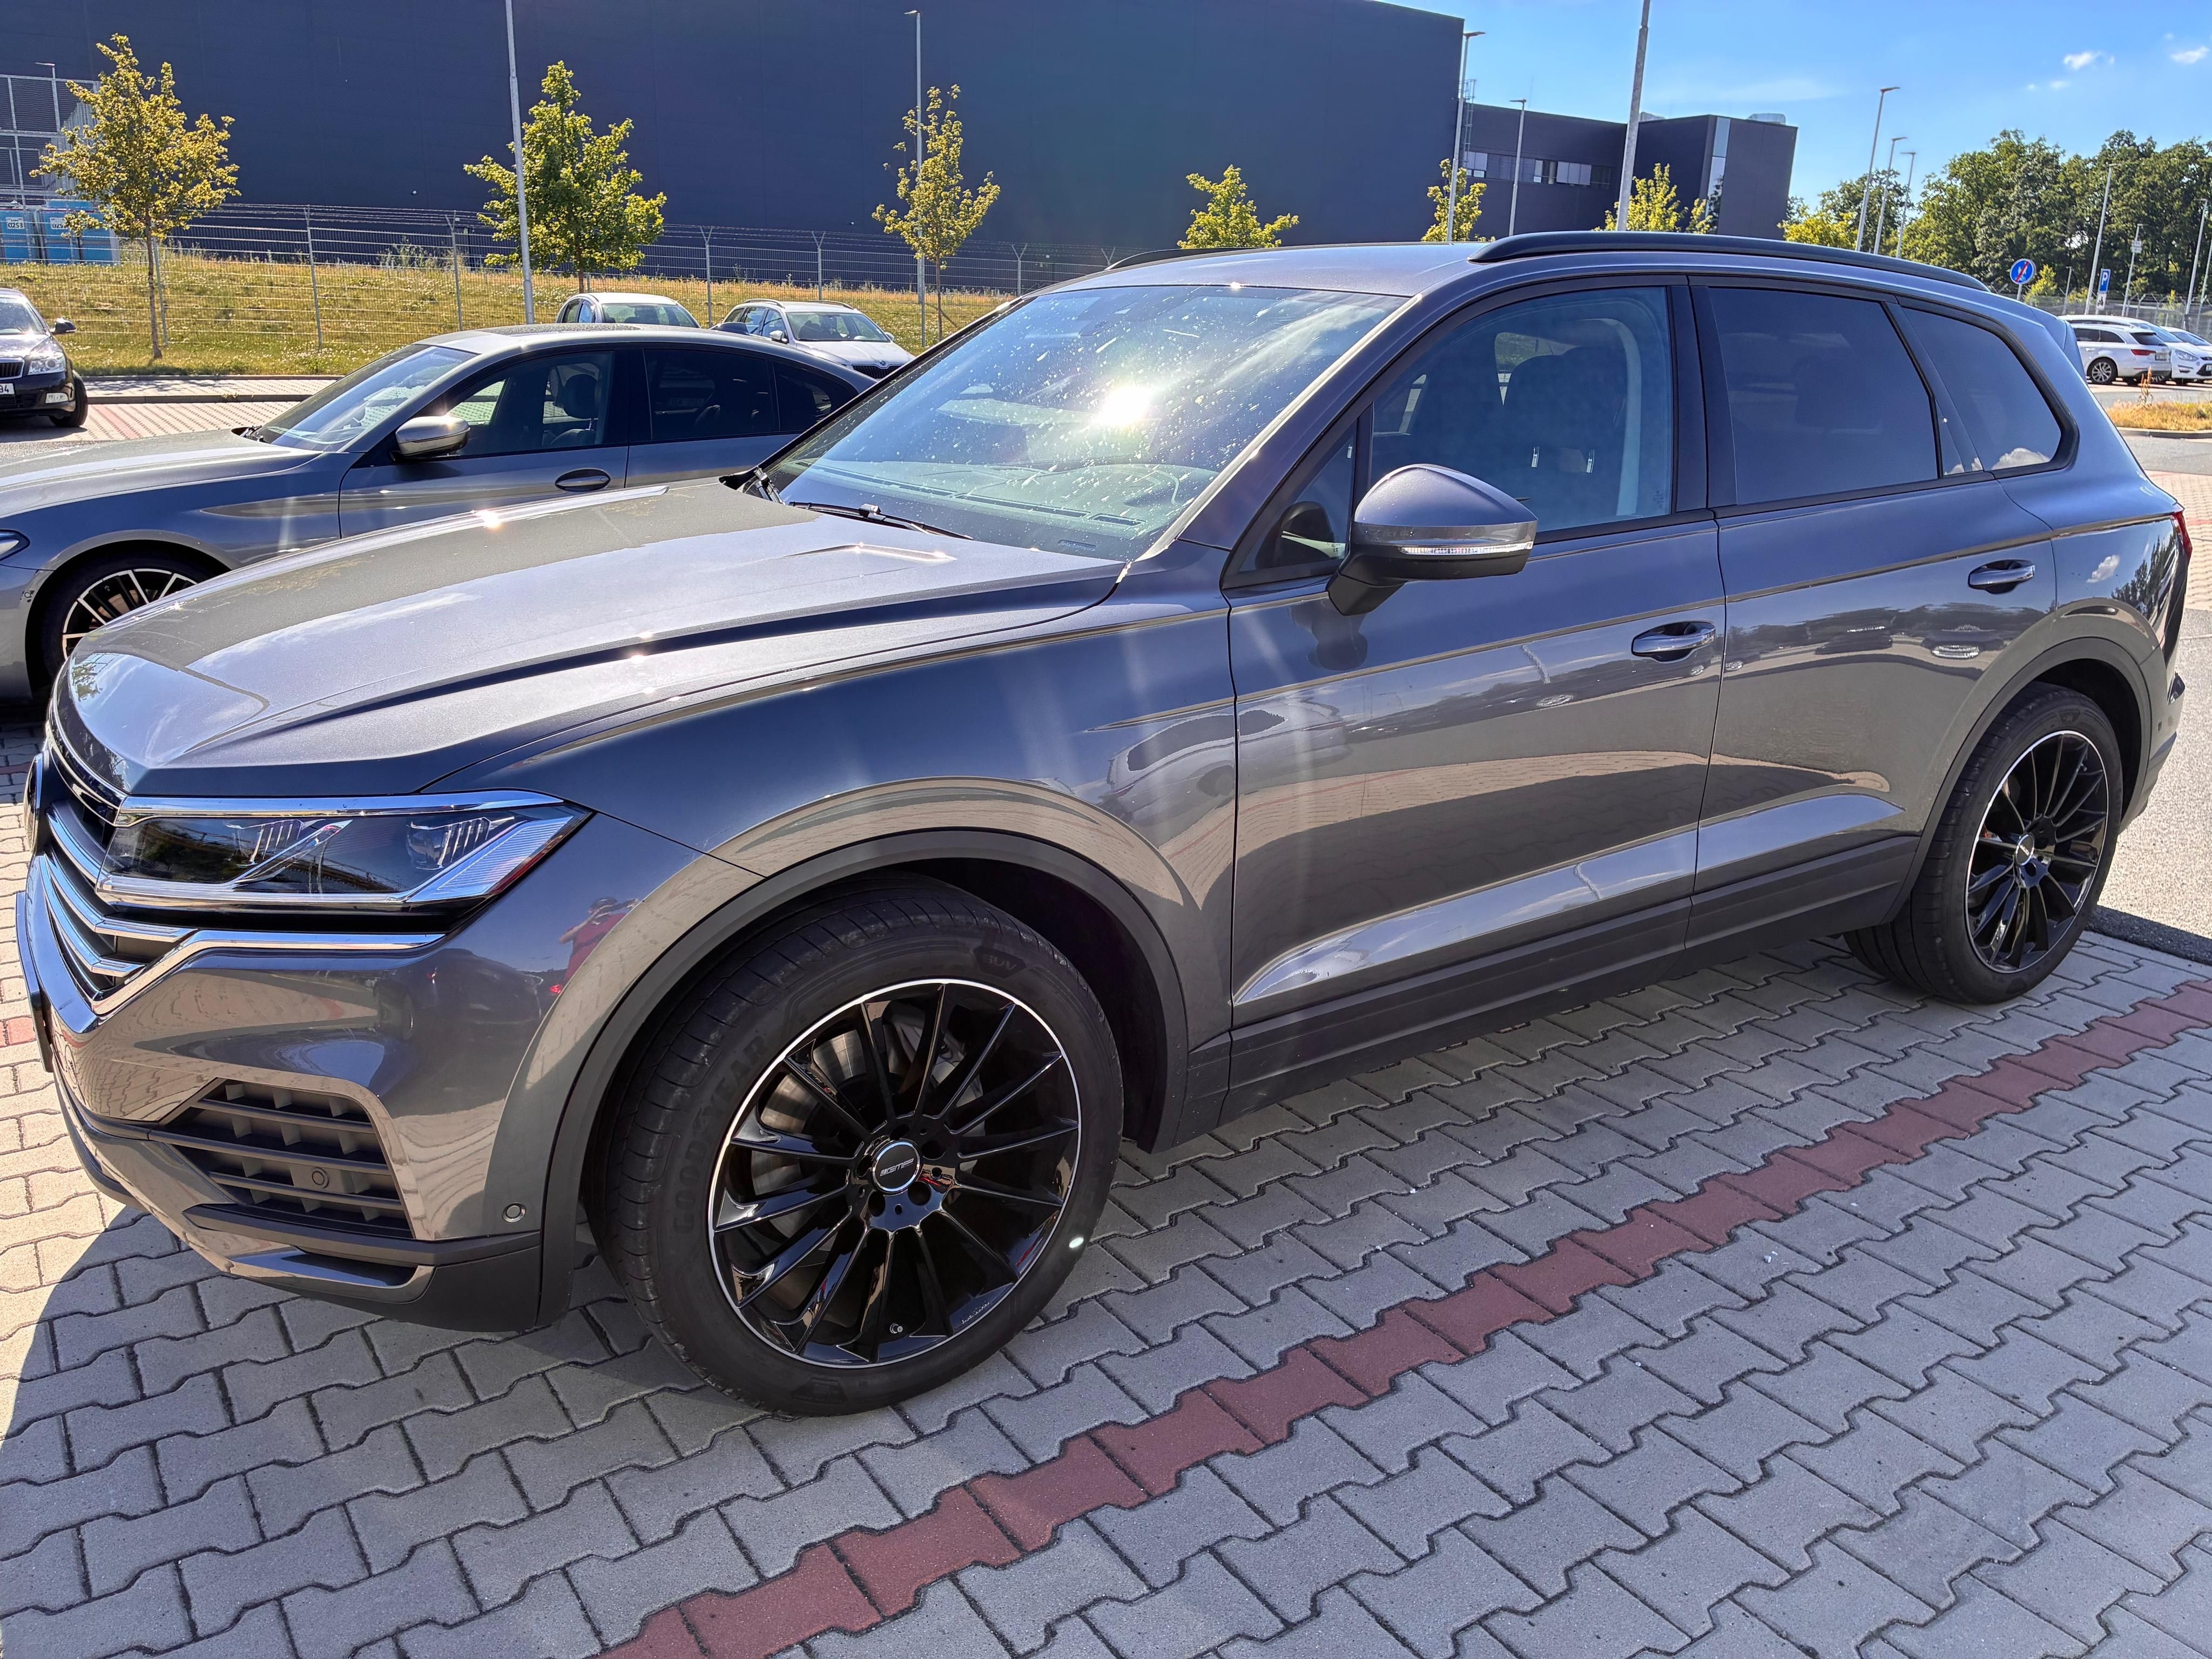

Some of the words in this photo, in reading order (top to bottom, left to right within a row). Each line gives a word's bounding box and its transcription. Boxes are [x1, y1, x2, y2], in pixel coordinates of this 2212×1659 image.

[2101, 272, 2108, 286] P
[983, 955, 1017, 970] SUV
[673, 1035, 769, 1235] GOODYEAR
